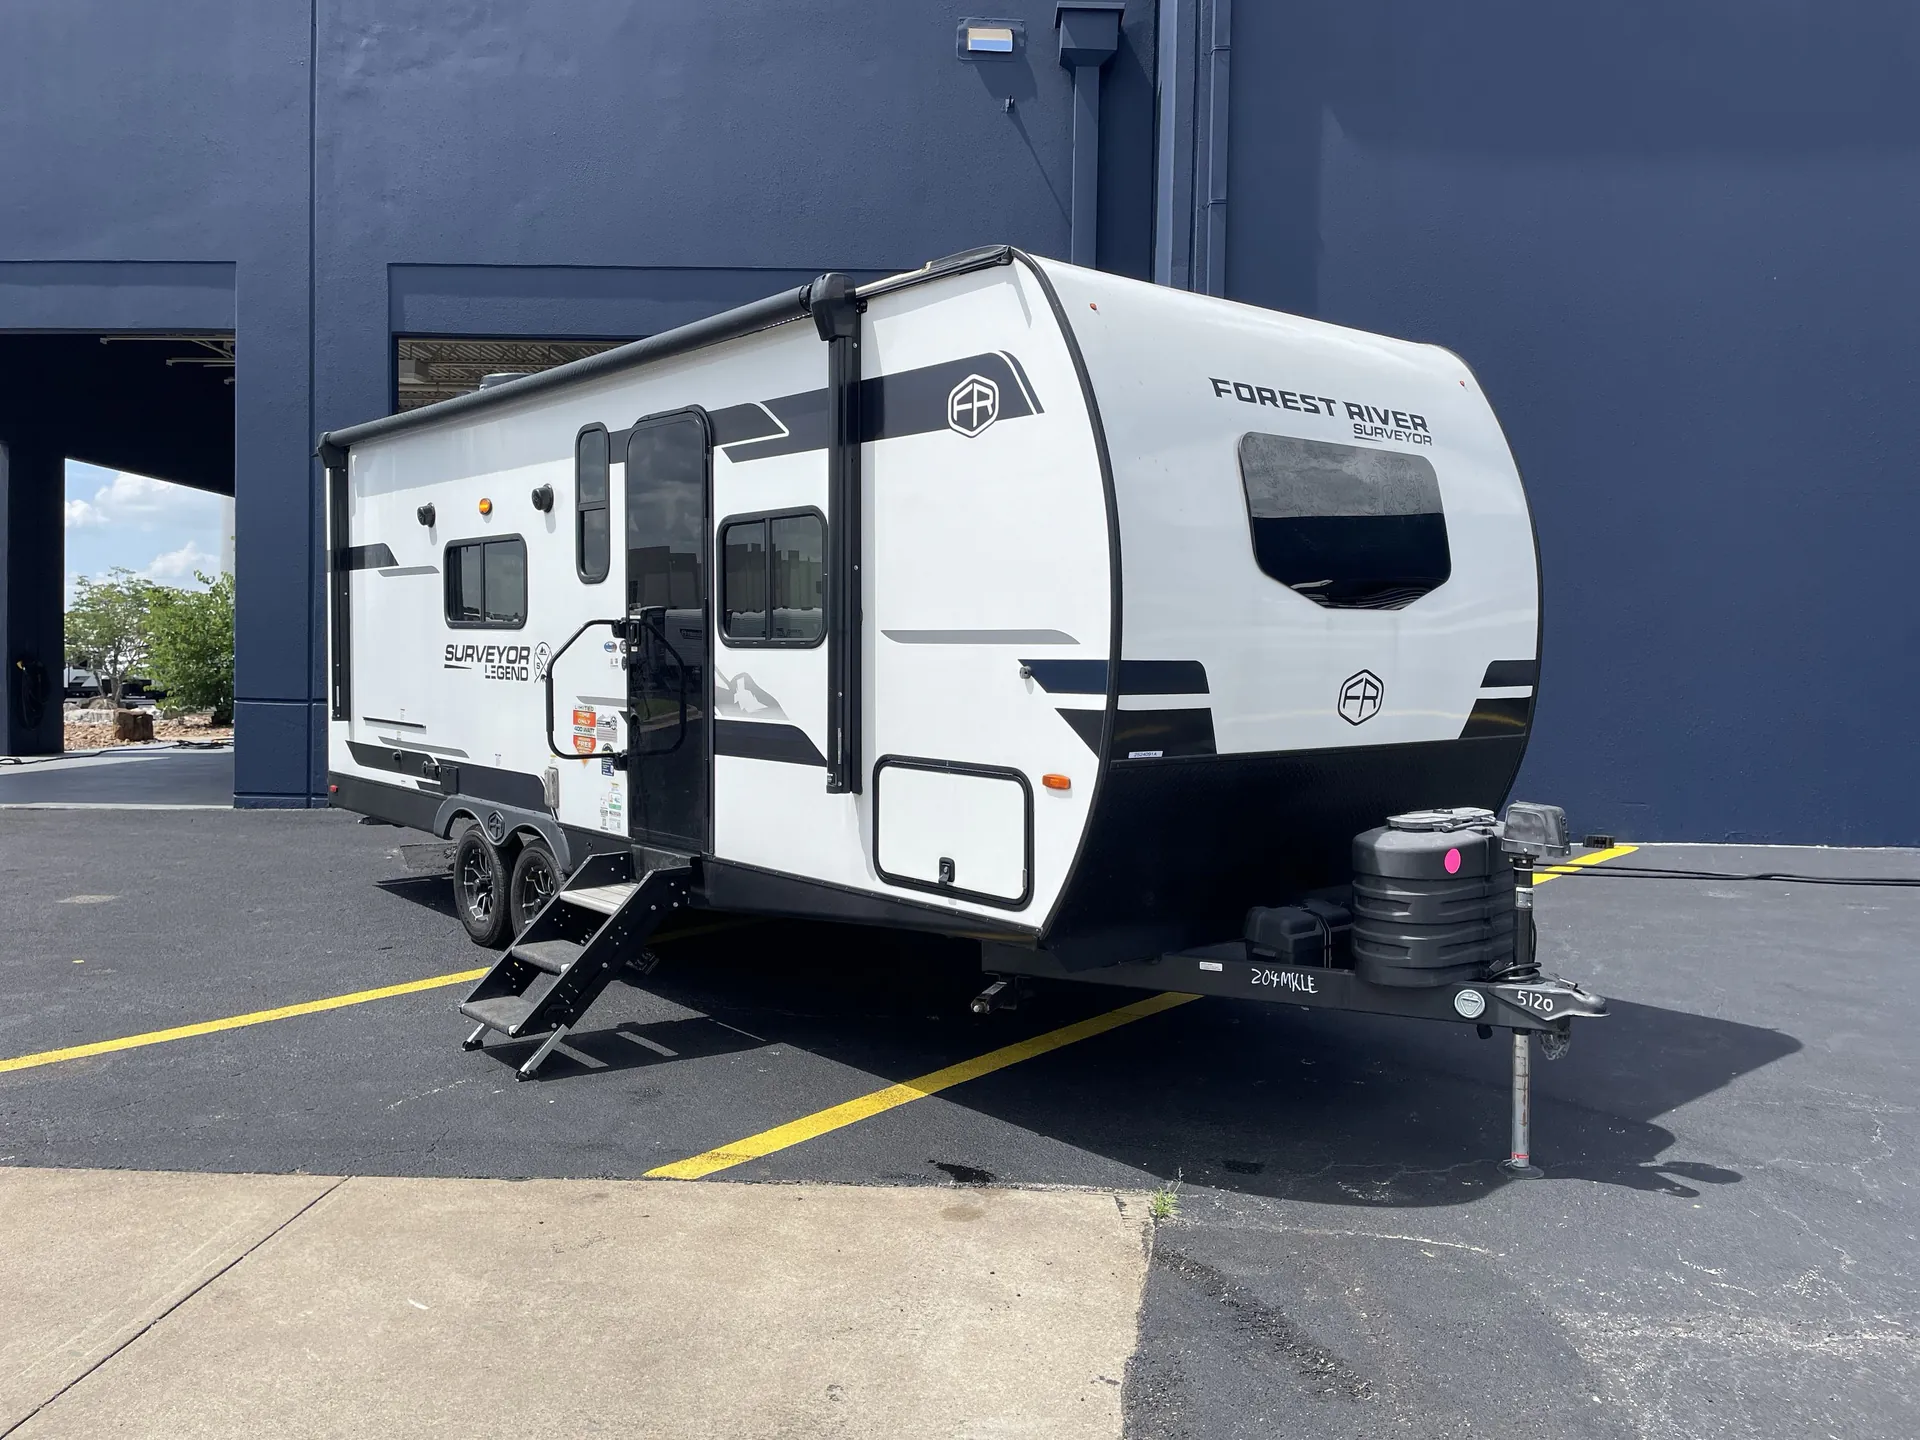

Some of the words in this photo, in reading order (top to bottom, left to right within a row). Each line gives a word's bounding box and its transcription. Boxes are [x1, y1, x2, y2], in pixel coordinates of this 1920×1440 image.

[1208, 377, 1336, 417] FOREST
[1342, 400, 1430, 433] RIVER
[1353, 423, 1432, 446] SURVEYOR
[444, 644, 531, 665] SURVEYOR
[484, 664, 529, 681] LEGEND
[577, 740, 592, 749] FREE
[1516, 990, 1554, 1012] 5120
